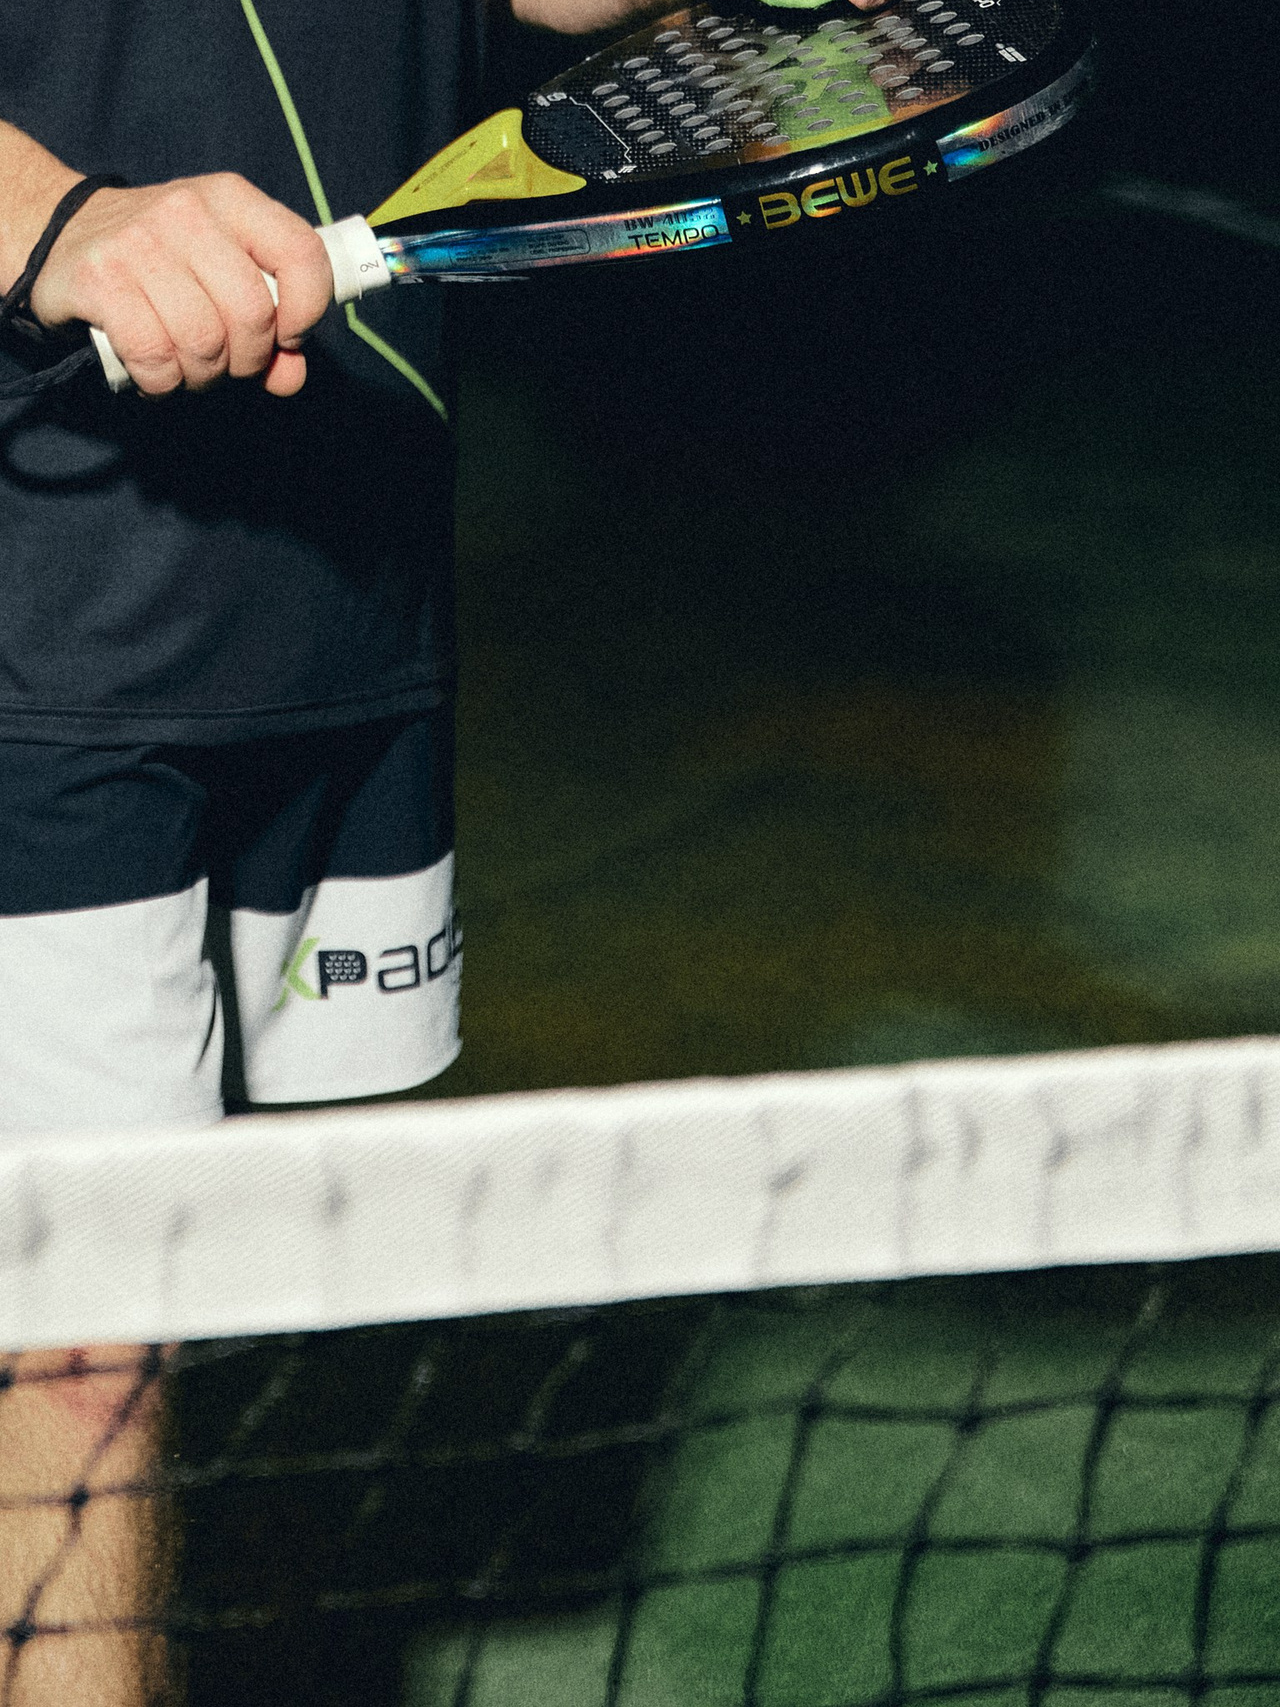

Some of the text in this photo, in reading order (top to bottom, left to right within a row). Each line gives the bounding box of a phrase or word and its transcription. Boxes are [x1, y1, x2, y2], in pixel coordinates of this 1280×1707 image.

[979, 110, 1047, 152] DESIGNED
[758, 155, 918, 230] BEWE
[628, 224, 719, 250] TEMPO
